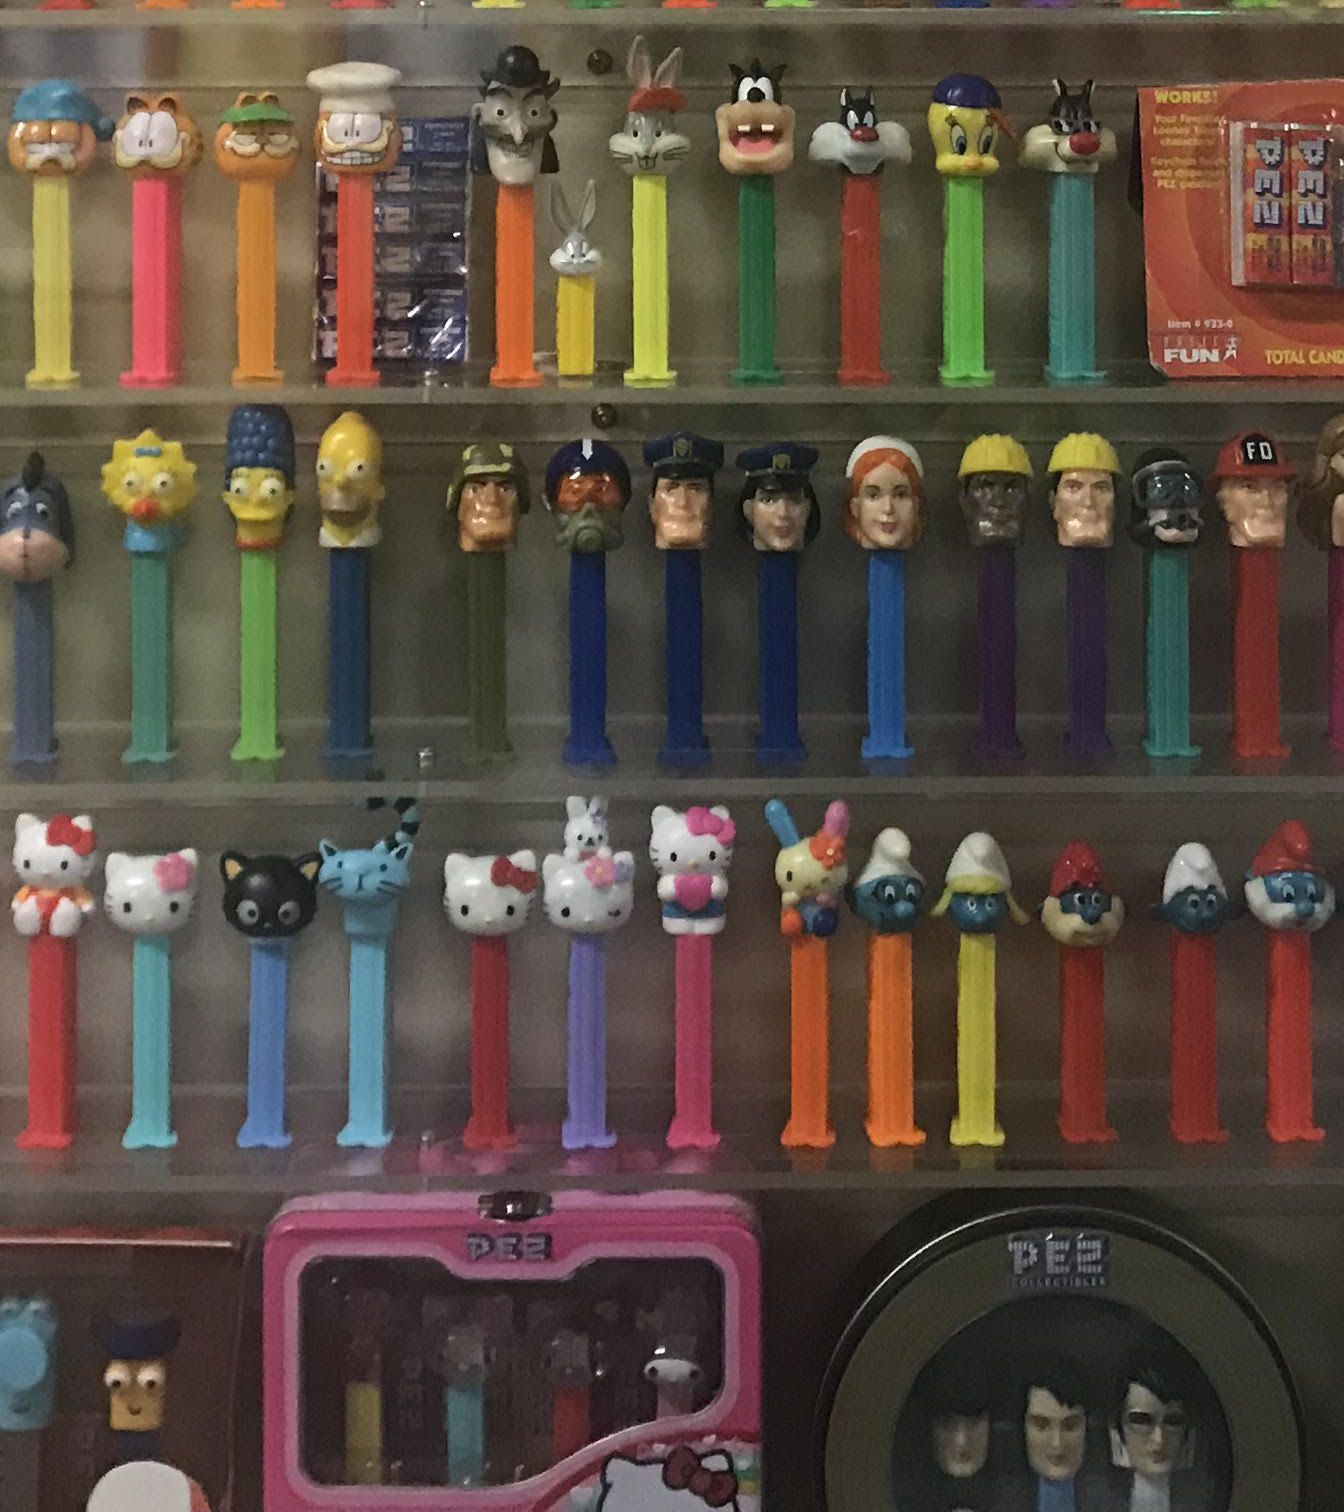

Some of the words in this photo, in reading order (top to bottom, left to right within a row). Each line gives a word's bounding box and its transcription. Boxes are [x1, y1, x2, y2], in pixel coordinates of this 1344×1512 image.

[1253, 136, 1282, 225] PEZ
[1297, 136, 1325, 225] PEZ
[1164, 349, 1220, 363] FUN
[1265, 349, 1305, 365] TOTAL
[467, 1234, 550, 1262] PEZ
[1007, 1239, 1103, 1275] PEZ
